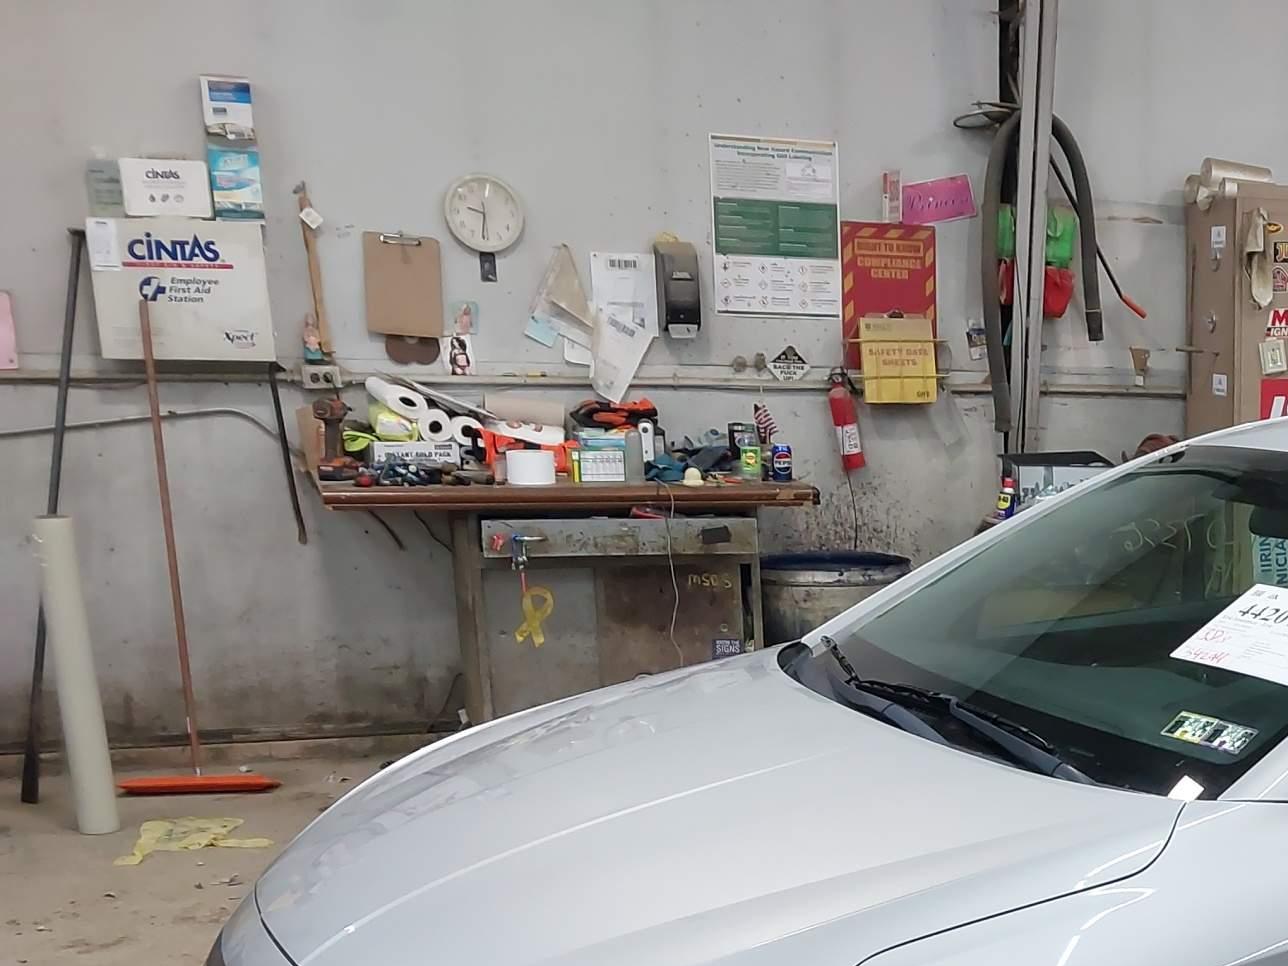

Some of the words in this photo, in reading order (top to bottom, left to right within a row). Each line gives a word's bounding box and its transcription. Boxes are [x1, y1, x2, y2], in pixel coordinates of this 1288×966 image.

[170, 276, 220, 286] Employee
[169, 286, 192, 294] First
[193, 286, 211, 294] Aid
[168, 295, 204, 303] Station
